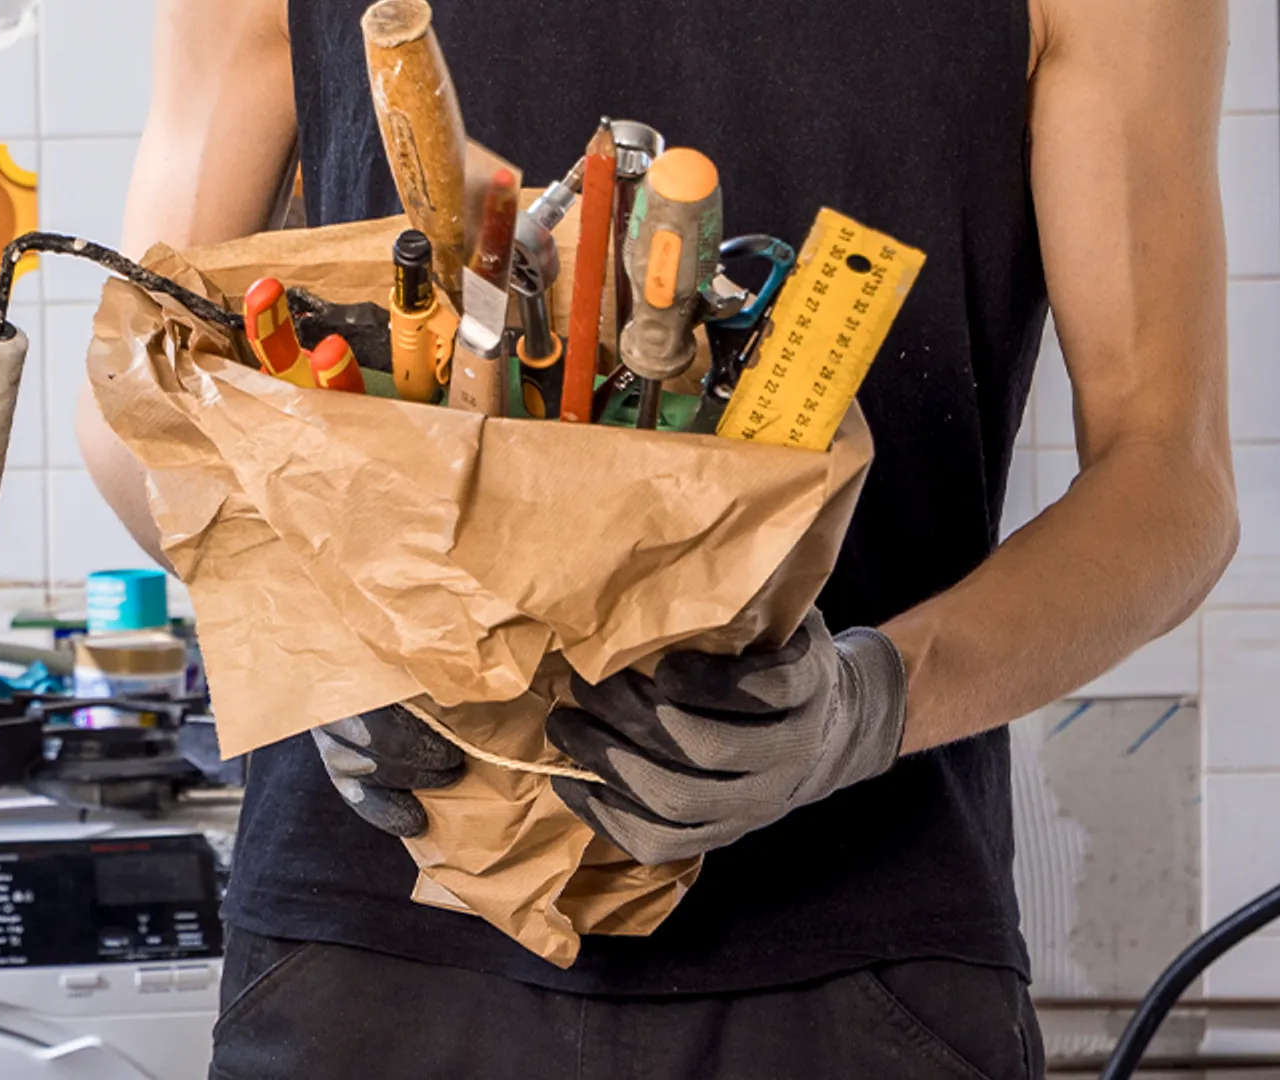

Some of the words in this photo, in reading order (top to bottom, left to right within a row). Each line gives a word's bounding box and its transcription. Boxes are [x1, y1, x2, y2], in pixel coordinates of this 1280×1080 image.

[838, 228, 855, 242] 31
[829, 244, 846, 260] 30
[821, 262, 837, 278] 29
[862, 282, 878, 296] 33
[806, 297, 820, 312] 27
[853, 299, 869, 314] 32
[845, 317, 861, 331] 31
[788, 331, 803, 345] 25
[781, 347, 795, 361] 24
[772, 364, 787, 377] 23
[820, 366, 835, 380] 28
[764, 379, 779, 394] 22
[813, 382, 827, 396] 27
[757, 396, 771, 409] 21
[789, 429, 803, 443] 24
